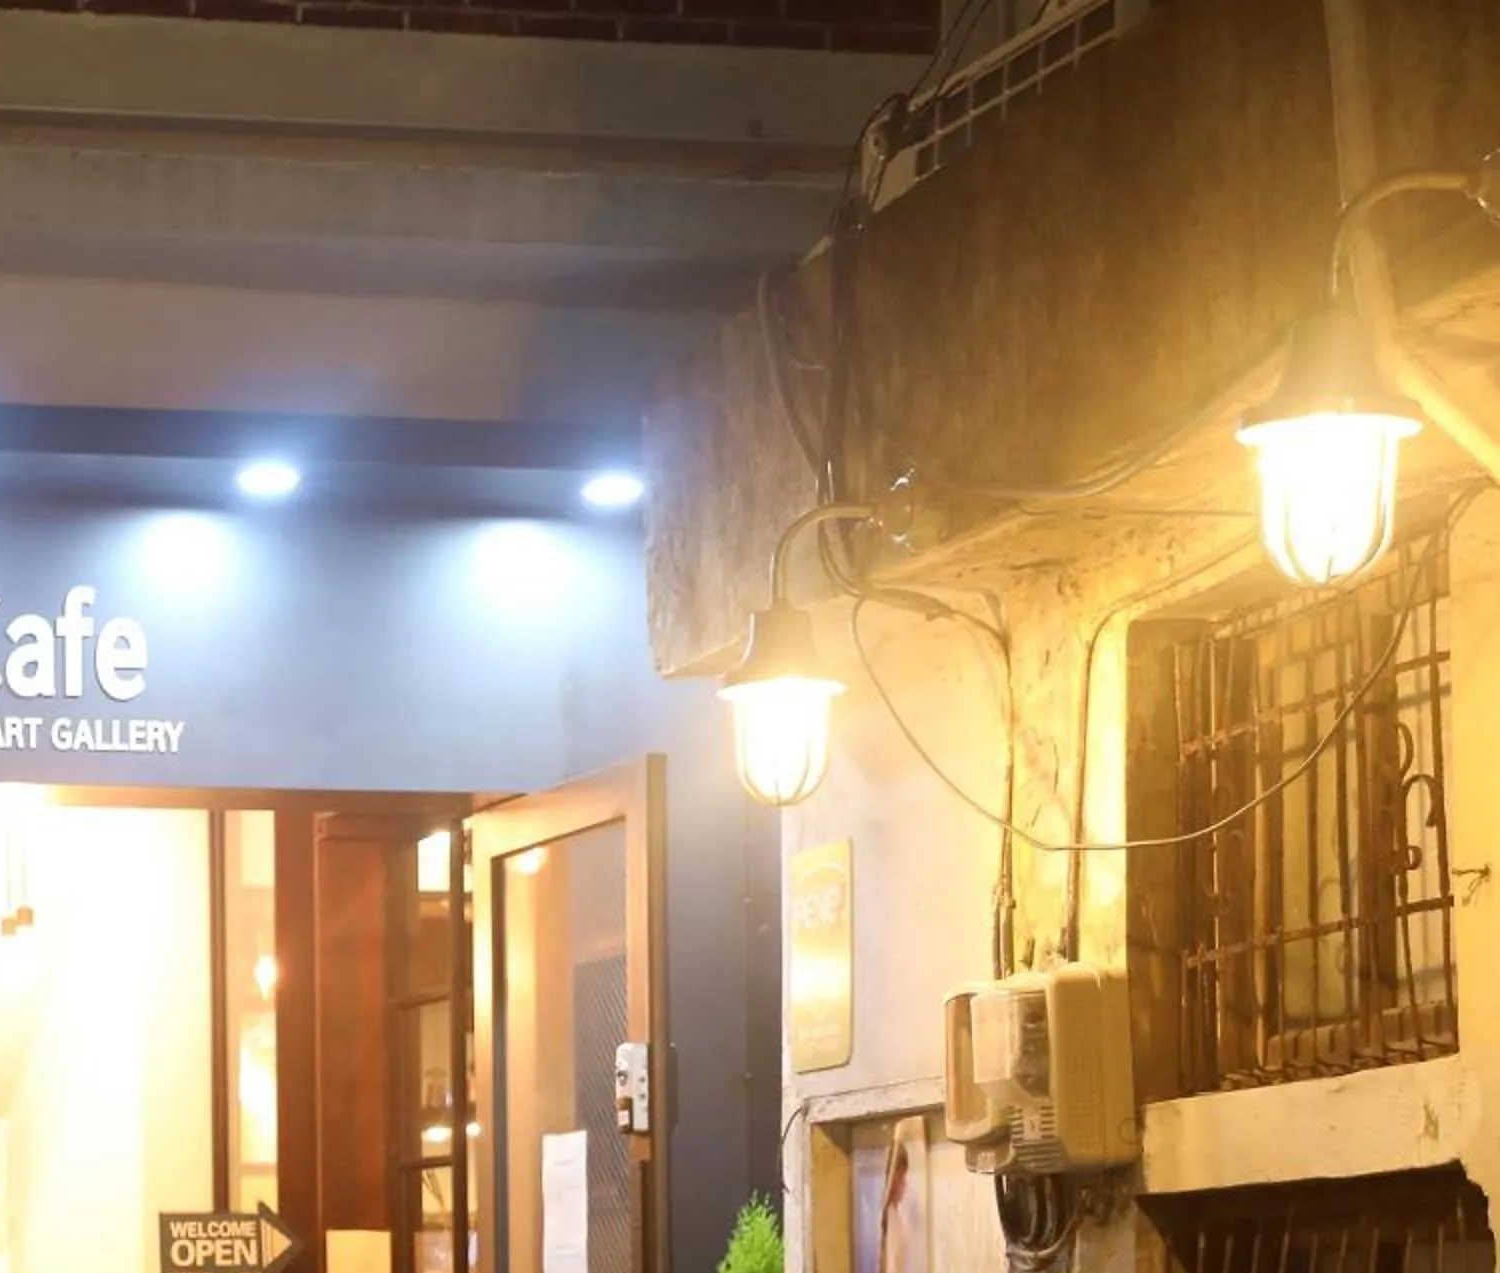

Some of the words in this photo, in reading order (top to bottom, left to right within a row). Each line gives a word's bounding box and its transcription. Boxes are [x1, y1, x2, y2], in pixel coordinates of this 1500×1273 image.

[51, 717, 184, 753] GALLERY
[170, 1220, 257, 1239] WELCOME
[170, 1239, 257, 1267] OPEN
